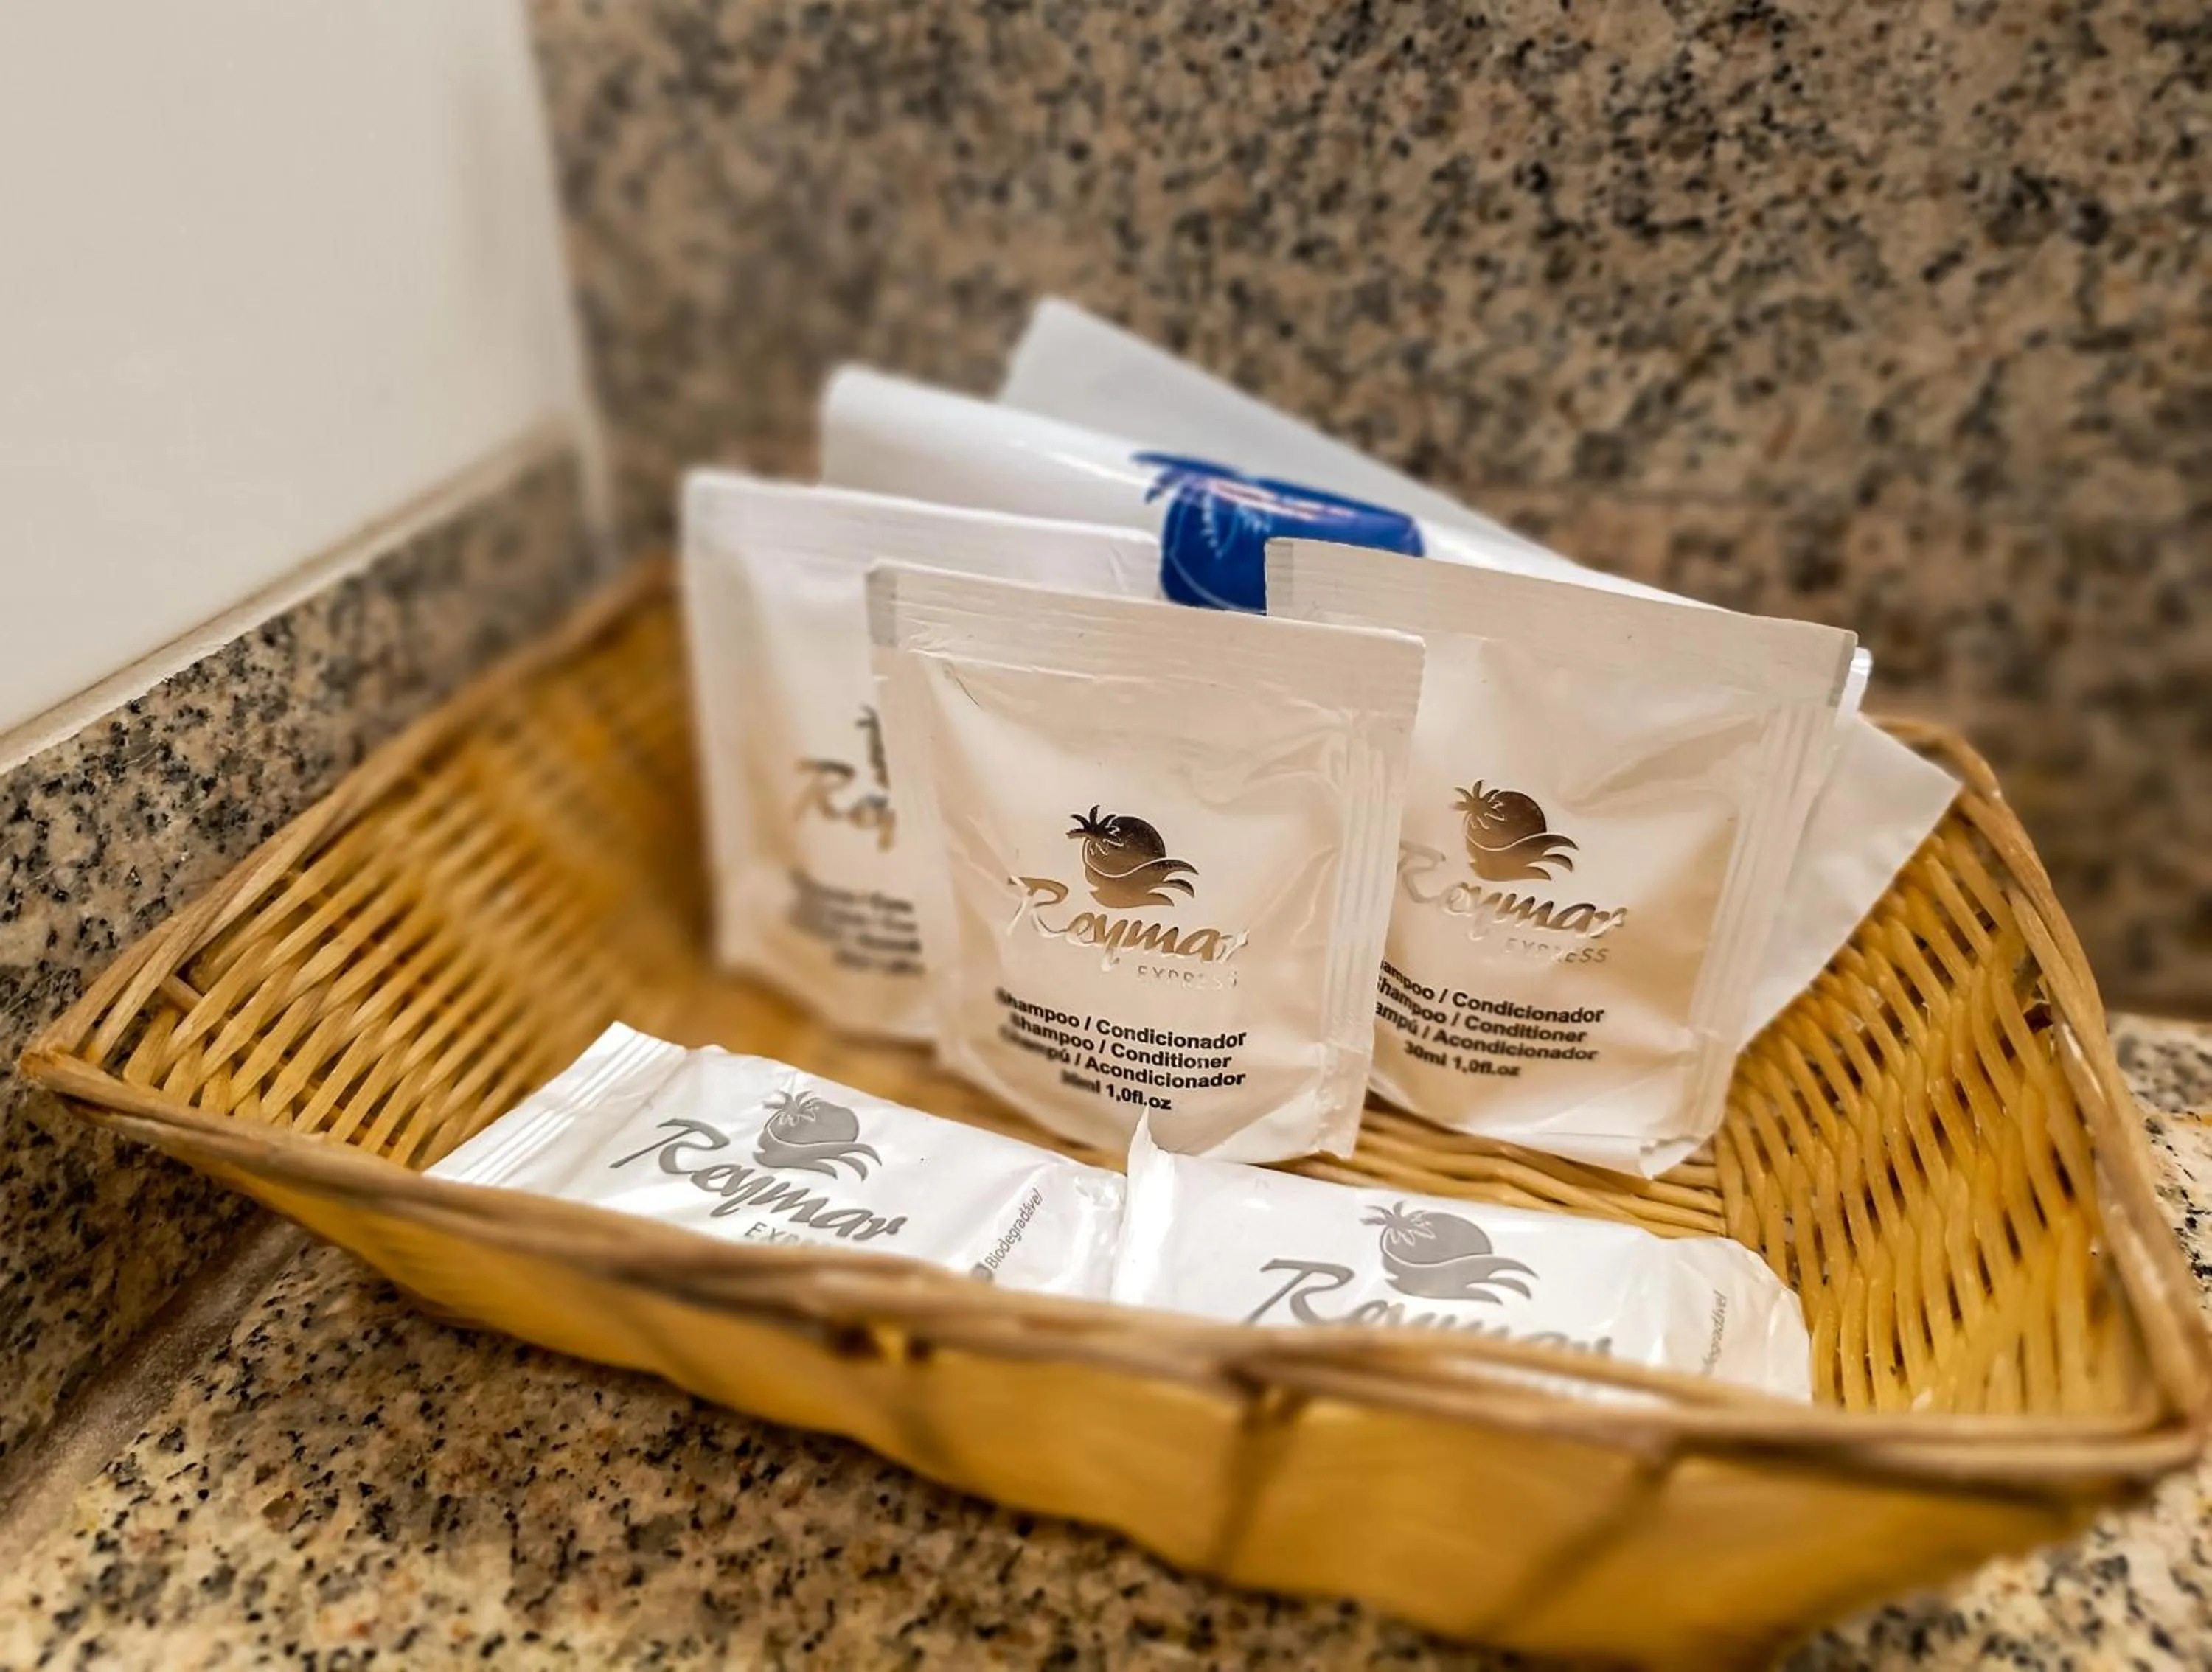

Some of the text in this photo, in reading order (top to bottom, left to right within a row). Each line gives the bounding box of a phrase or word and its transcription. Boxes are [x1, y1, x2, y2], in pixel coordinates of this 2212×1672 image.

[1380, 960, 1435, 1000] ampoo
[1452, 992, 1604, 1023] Condicionador
[1377, 974, 1447, 1023] hampoo
[1464, 1015, 1587, 1043] Conditioner
[1096, 1020, 1246, 1049] Condicionador
[1433, 1028, 1599, 1060] Acondicionador
[1111, 1043, 1231, 1068] Conditioner
[1404, 1039, 1447, 1067] 30ml
[1085, 1056, 1246, 1089] Acondicionador
[609, 1118, 908, 1241] Reymar
[984, 1187, 1043, 1269] Biodegradável
